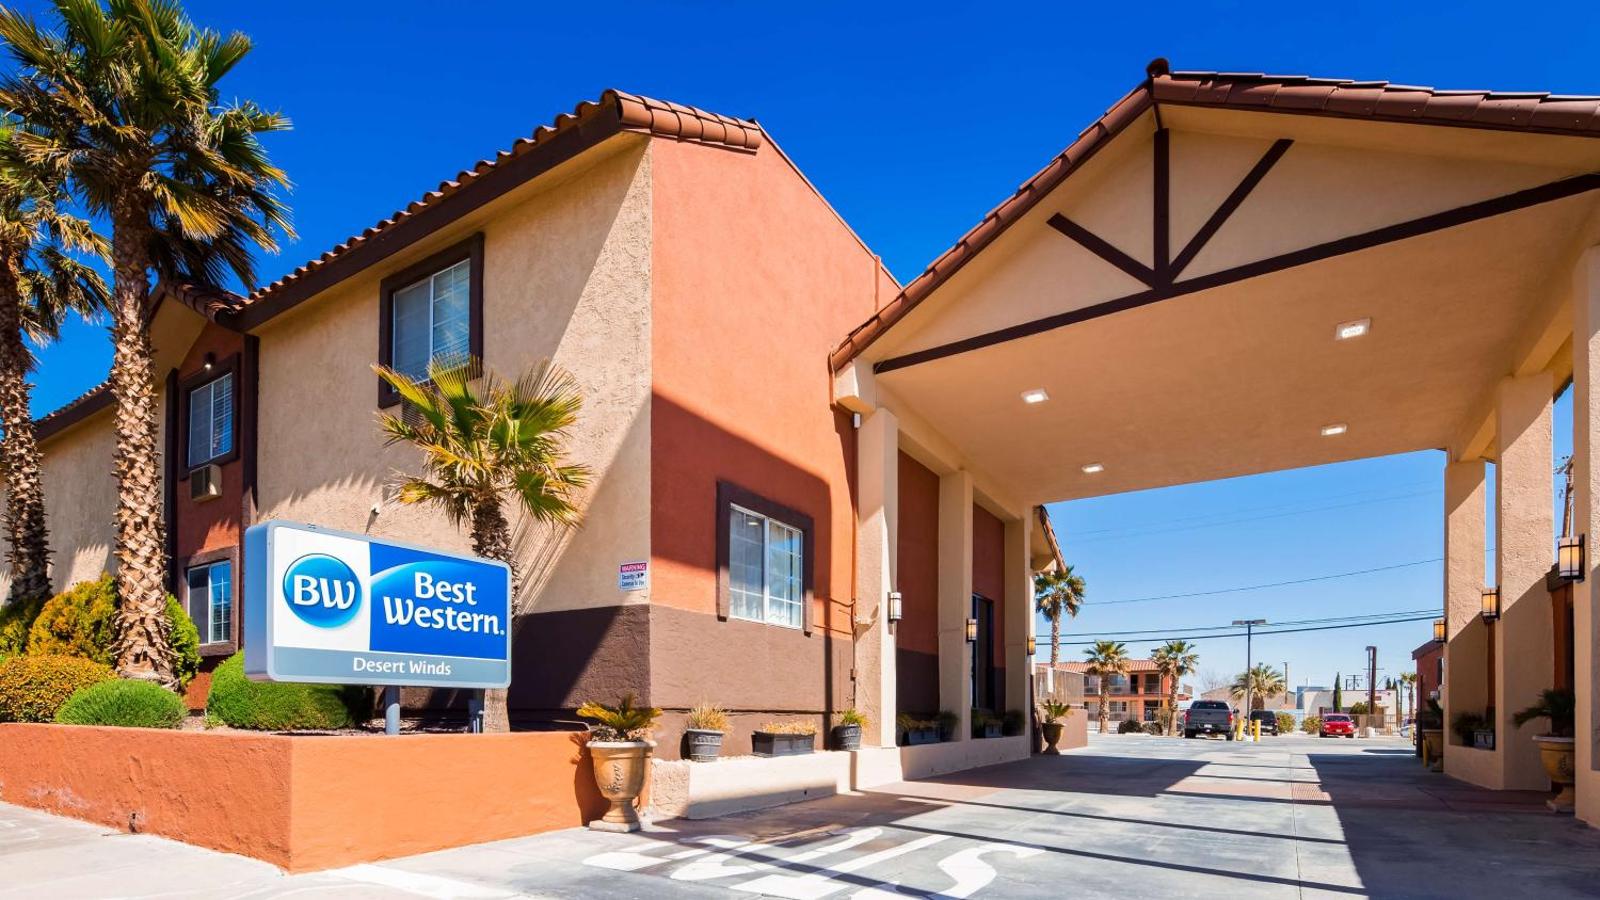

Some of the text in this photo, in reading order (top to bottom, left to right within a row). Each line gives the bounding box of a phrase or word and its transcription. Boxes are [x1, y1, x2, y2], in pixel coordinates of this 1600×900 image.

[293, 575, 355, 609] BW
[414, 572, 477, 605] Best
[352, 656, 452, 676] Desert Winds
